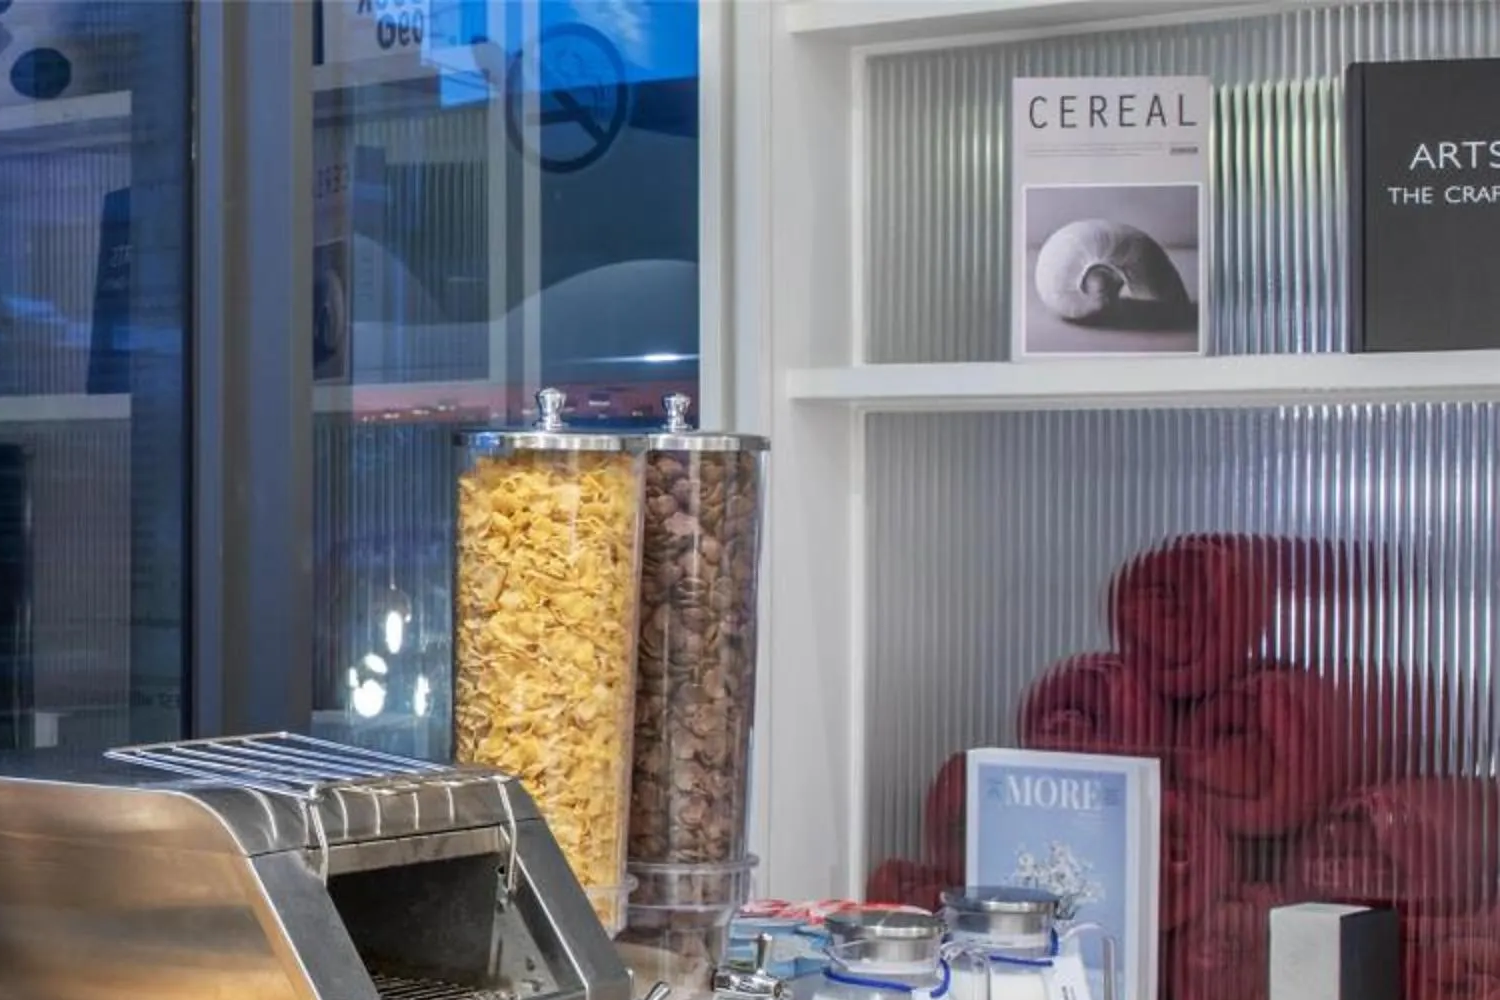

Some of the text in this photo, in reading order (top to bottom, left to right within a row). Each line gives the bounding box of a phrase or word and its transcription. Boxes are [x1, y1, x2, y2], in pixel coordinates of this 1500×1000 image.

[1028, 93, 1198, 129] CEREAL
[1408, 141, 1500, 170] ARTS
[1387, 186, 1433, 205] THE
[1005, 774, 1103, 811] MORE
